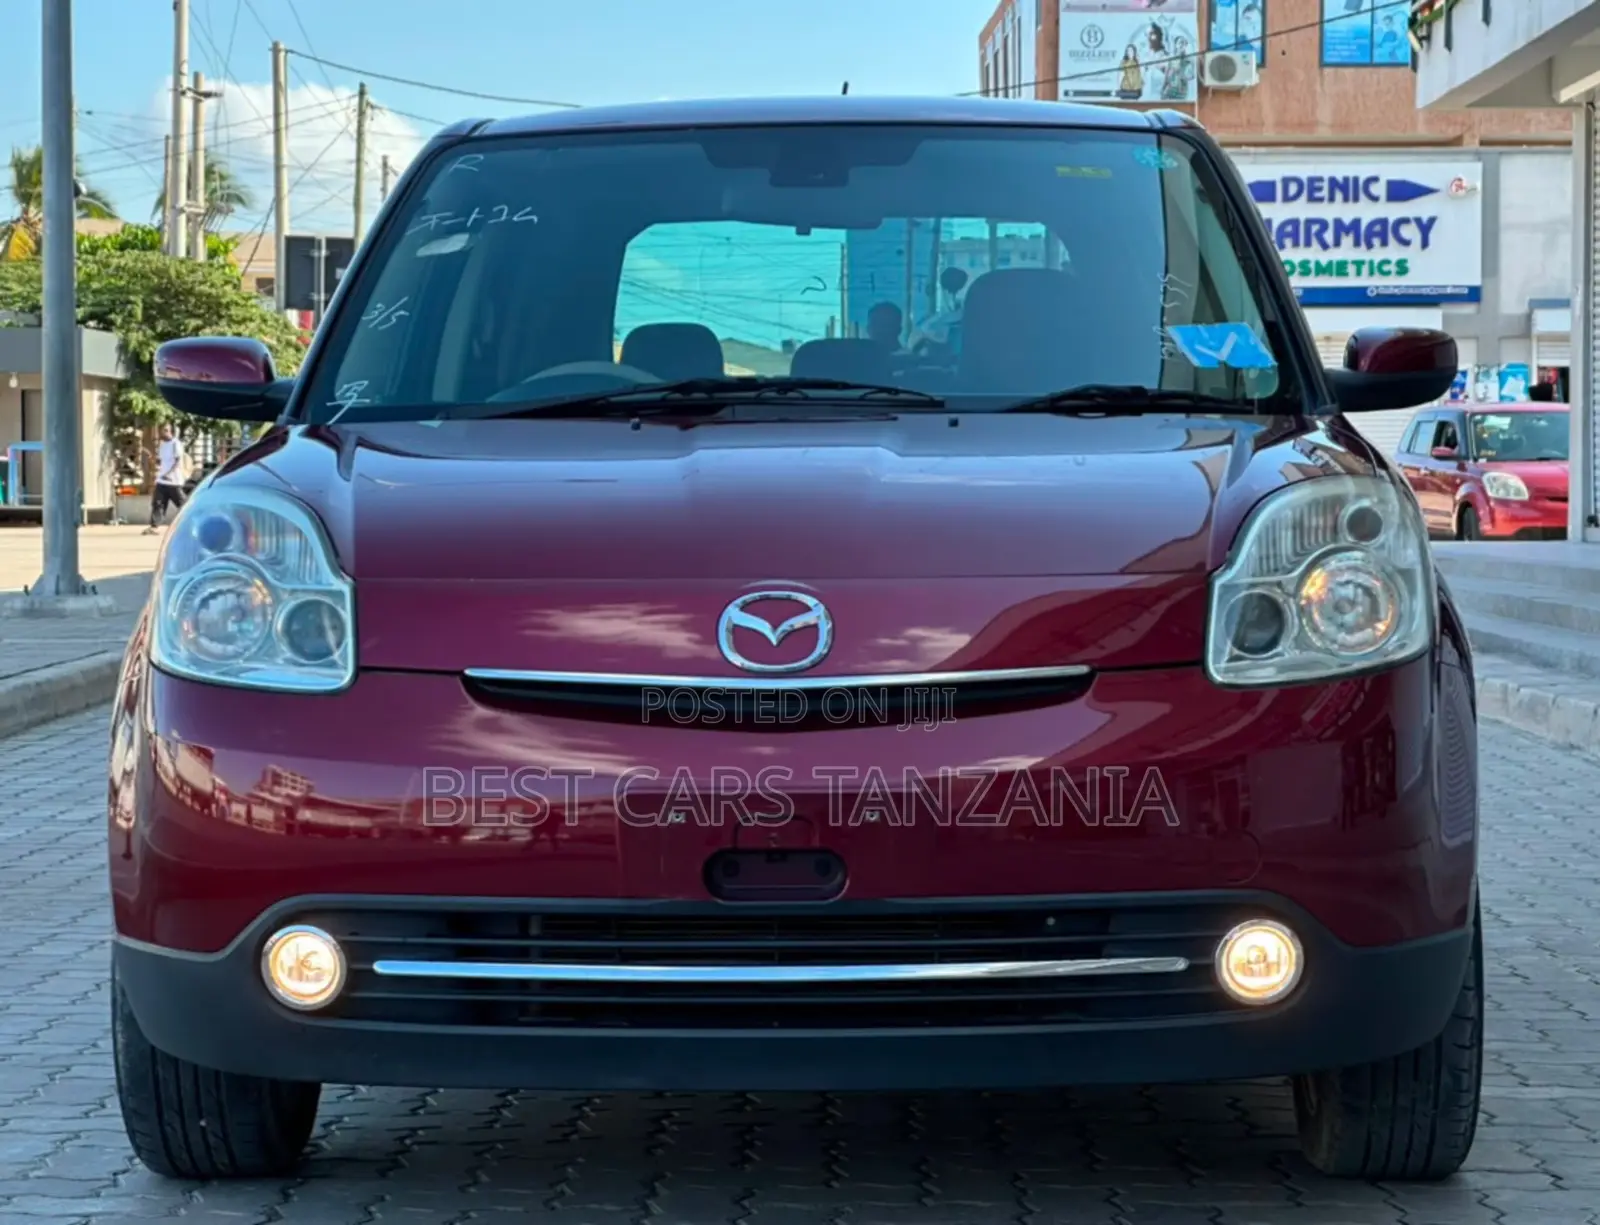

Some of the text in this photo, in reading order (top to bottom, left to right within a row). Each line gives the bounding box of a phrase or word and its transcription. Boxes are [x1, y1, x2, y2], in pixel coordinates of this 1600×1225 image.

[1281, 175, 1382, 204] DENIC
[1262, 216, 1439, 252] ARMACY
[1281, 258, 1411, 278] OSMETICS
